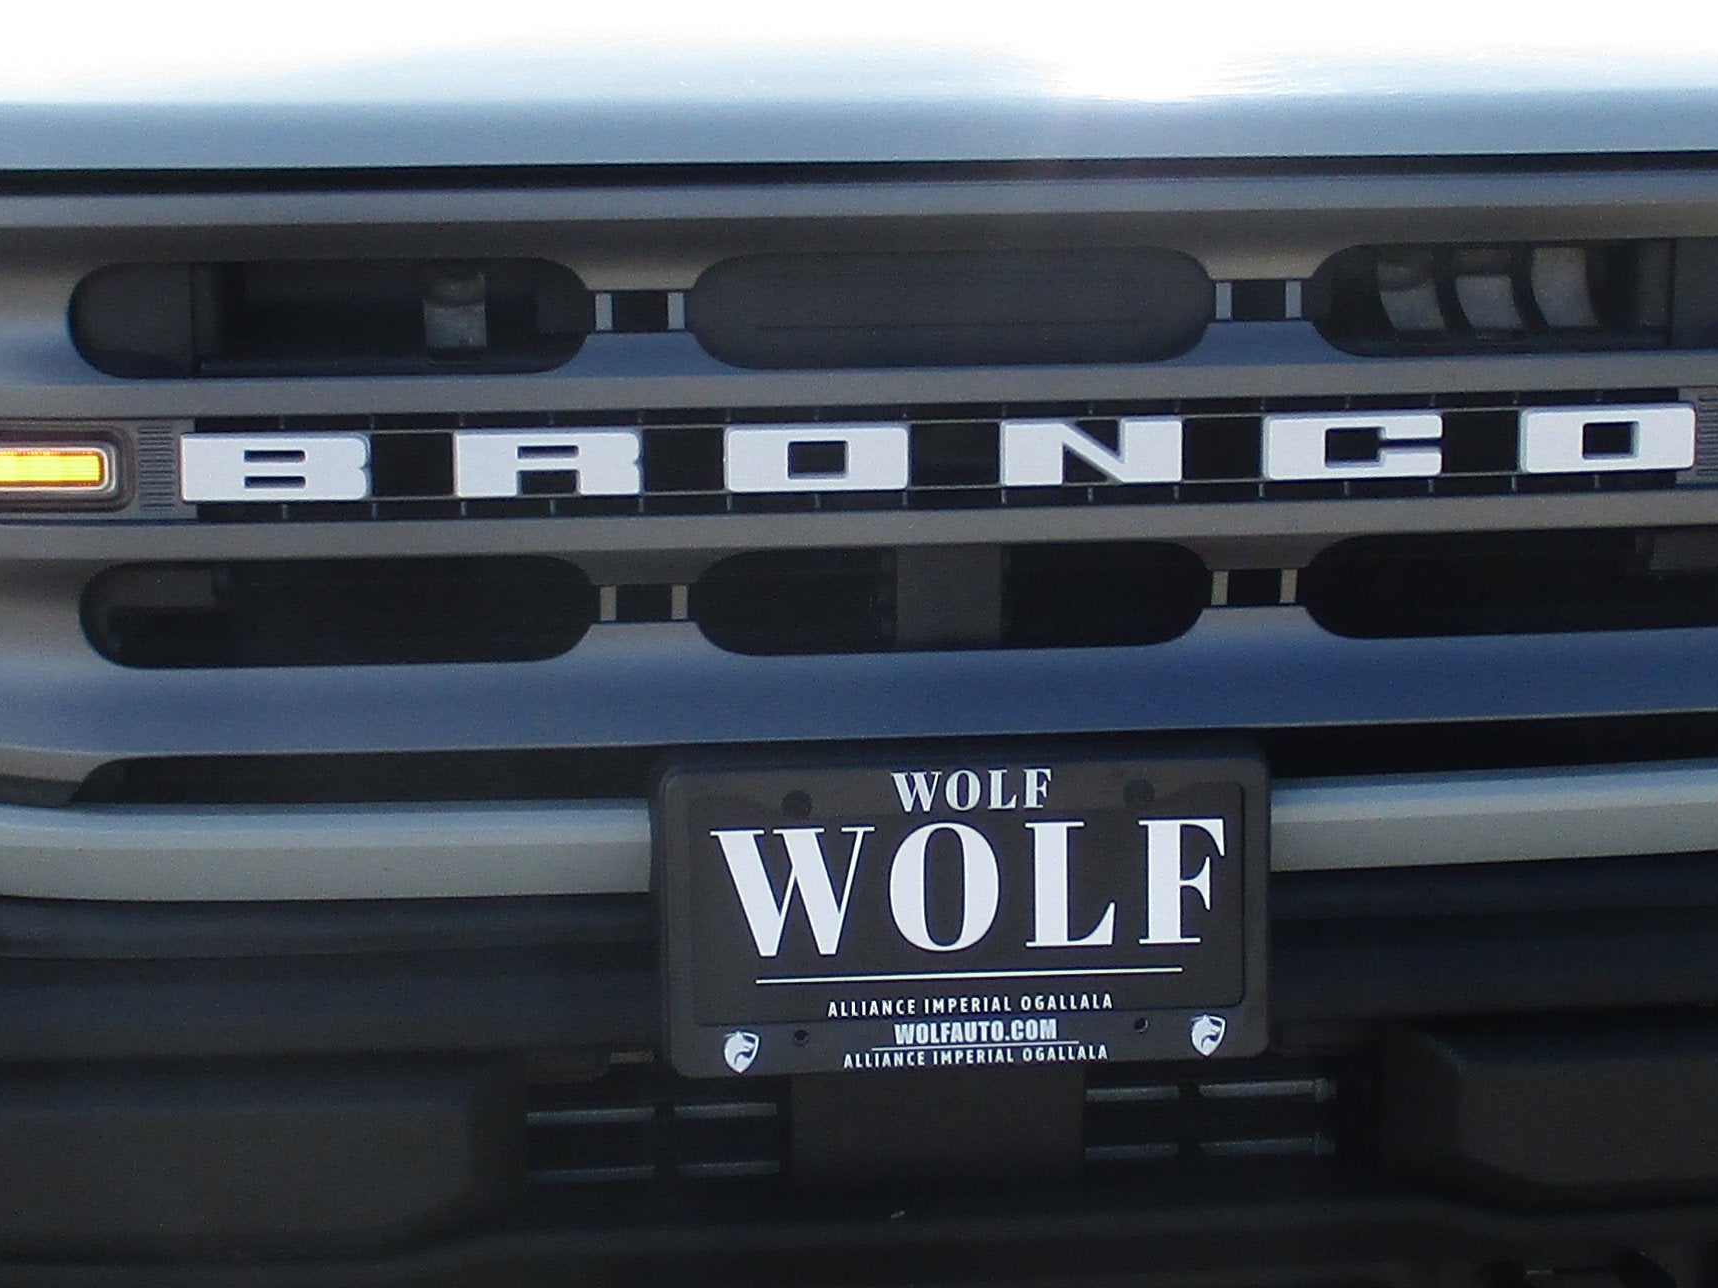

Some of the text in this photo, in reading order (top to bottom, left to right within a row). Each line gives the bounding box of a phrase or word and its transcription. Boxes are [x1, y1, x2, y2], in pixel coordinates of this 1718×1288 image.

[180, 403, 1696, 503] BRONCO
[891, 767, 1053, 812] WOLF
[710, 818, 1227, 958] WOLF
[827, 993, 1113, 1018] ALLIANCE IMPERIAL OGALLALA
[894, 1018, 1058, 1045] WOLFAUTO.COM
[843, 1044, 1109, 1069] ALLIANCE IMPERIAL OGALLALA
